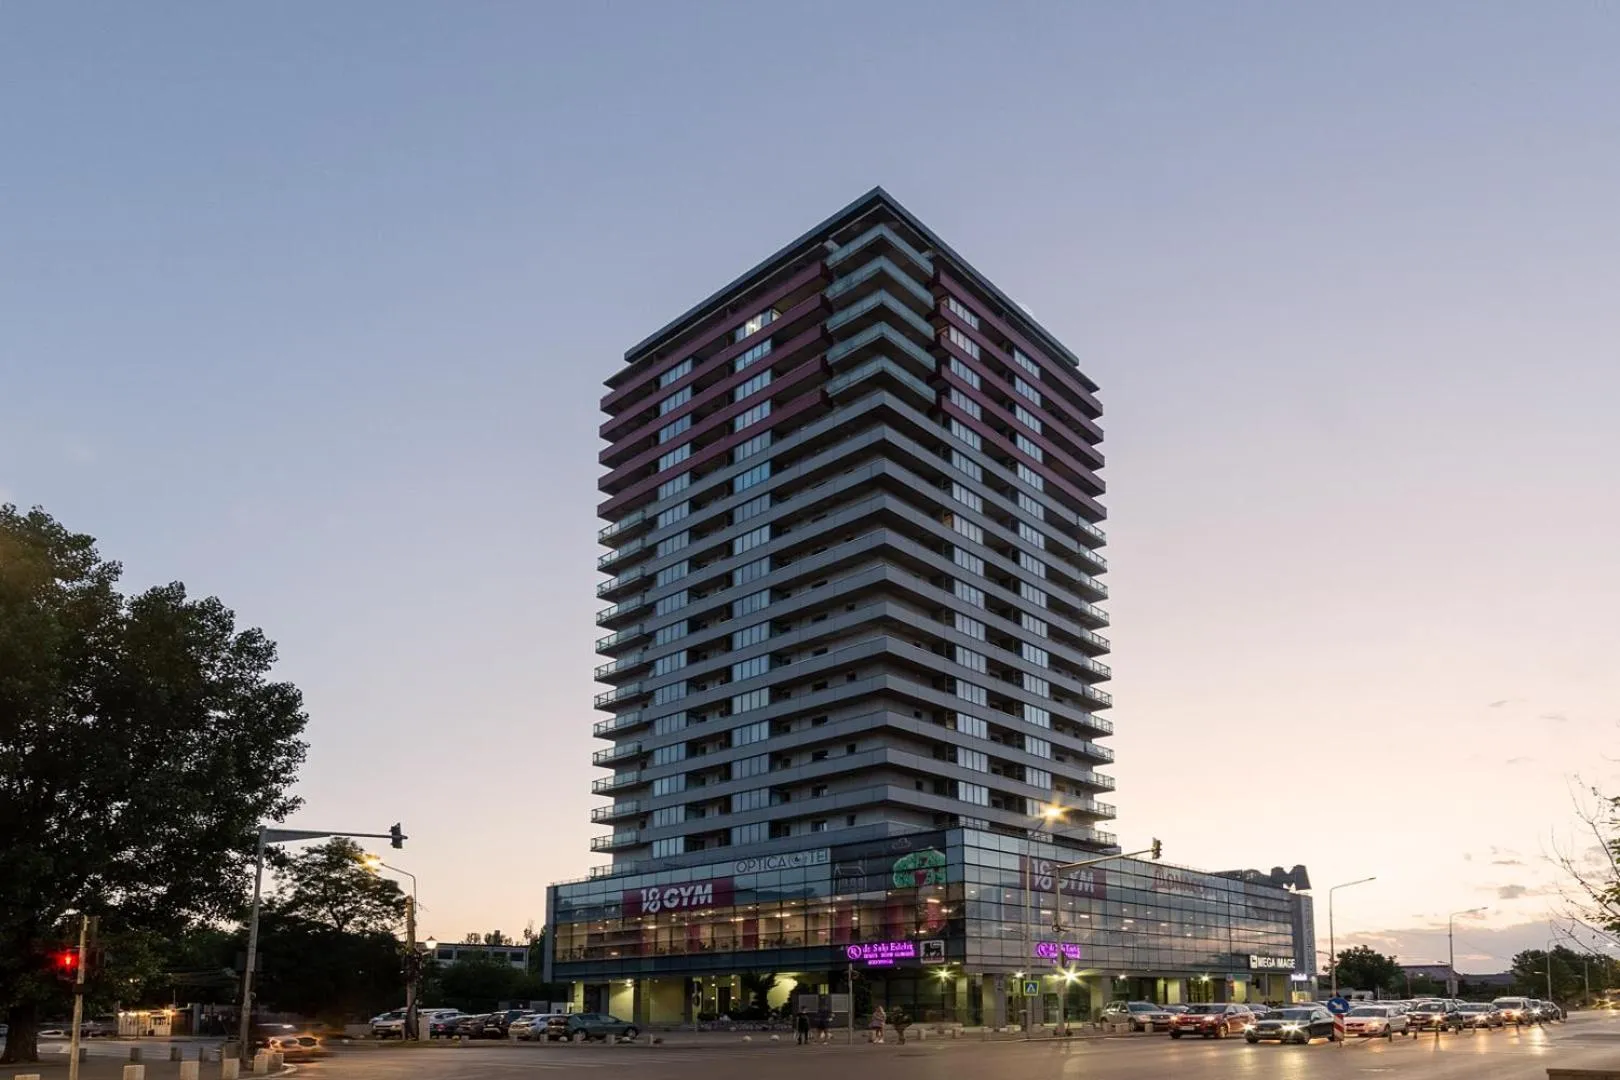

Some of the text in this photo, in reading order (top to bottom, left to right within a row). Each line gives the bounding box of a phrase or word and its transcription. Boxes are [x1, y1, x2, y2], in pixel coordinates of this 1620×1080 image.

[736, 856, 786, 873] OPTICA
[1257, 957, 1296, 969] MEGA IMAGE
